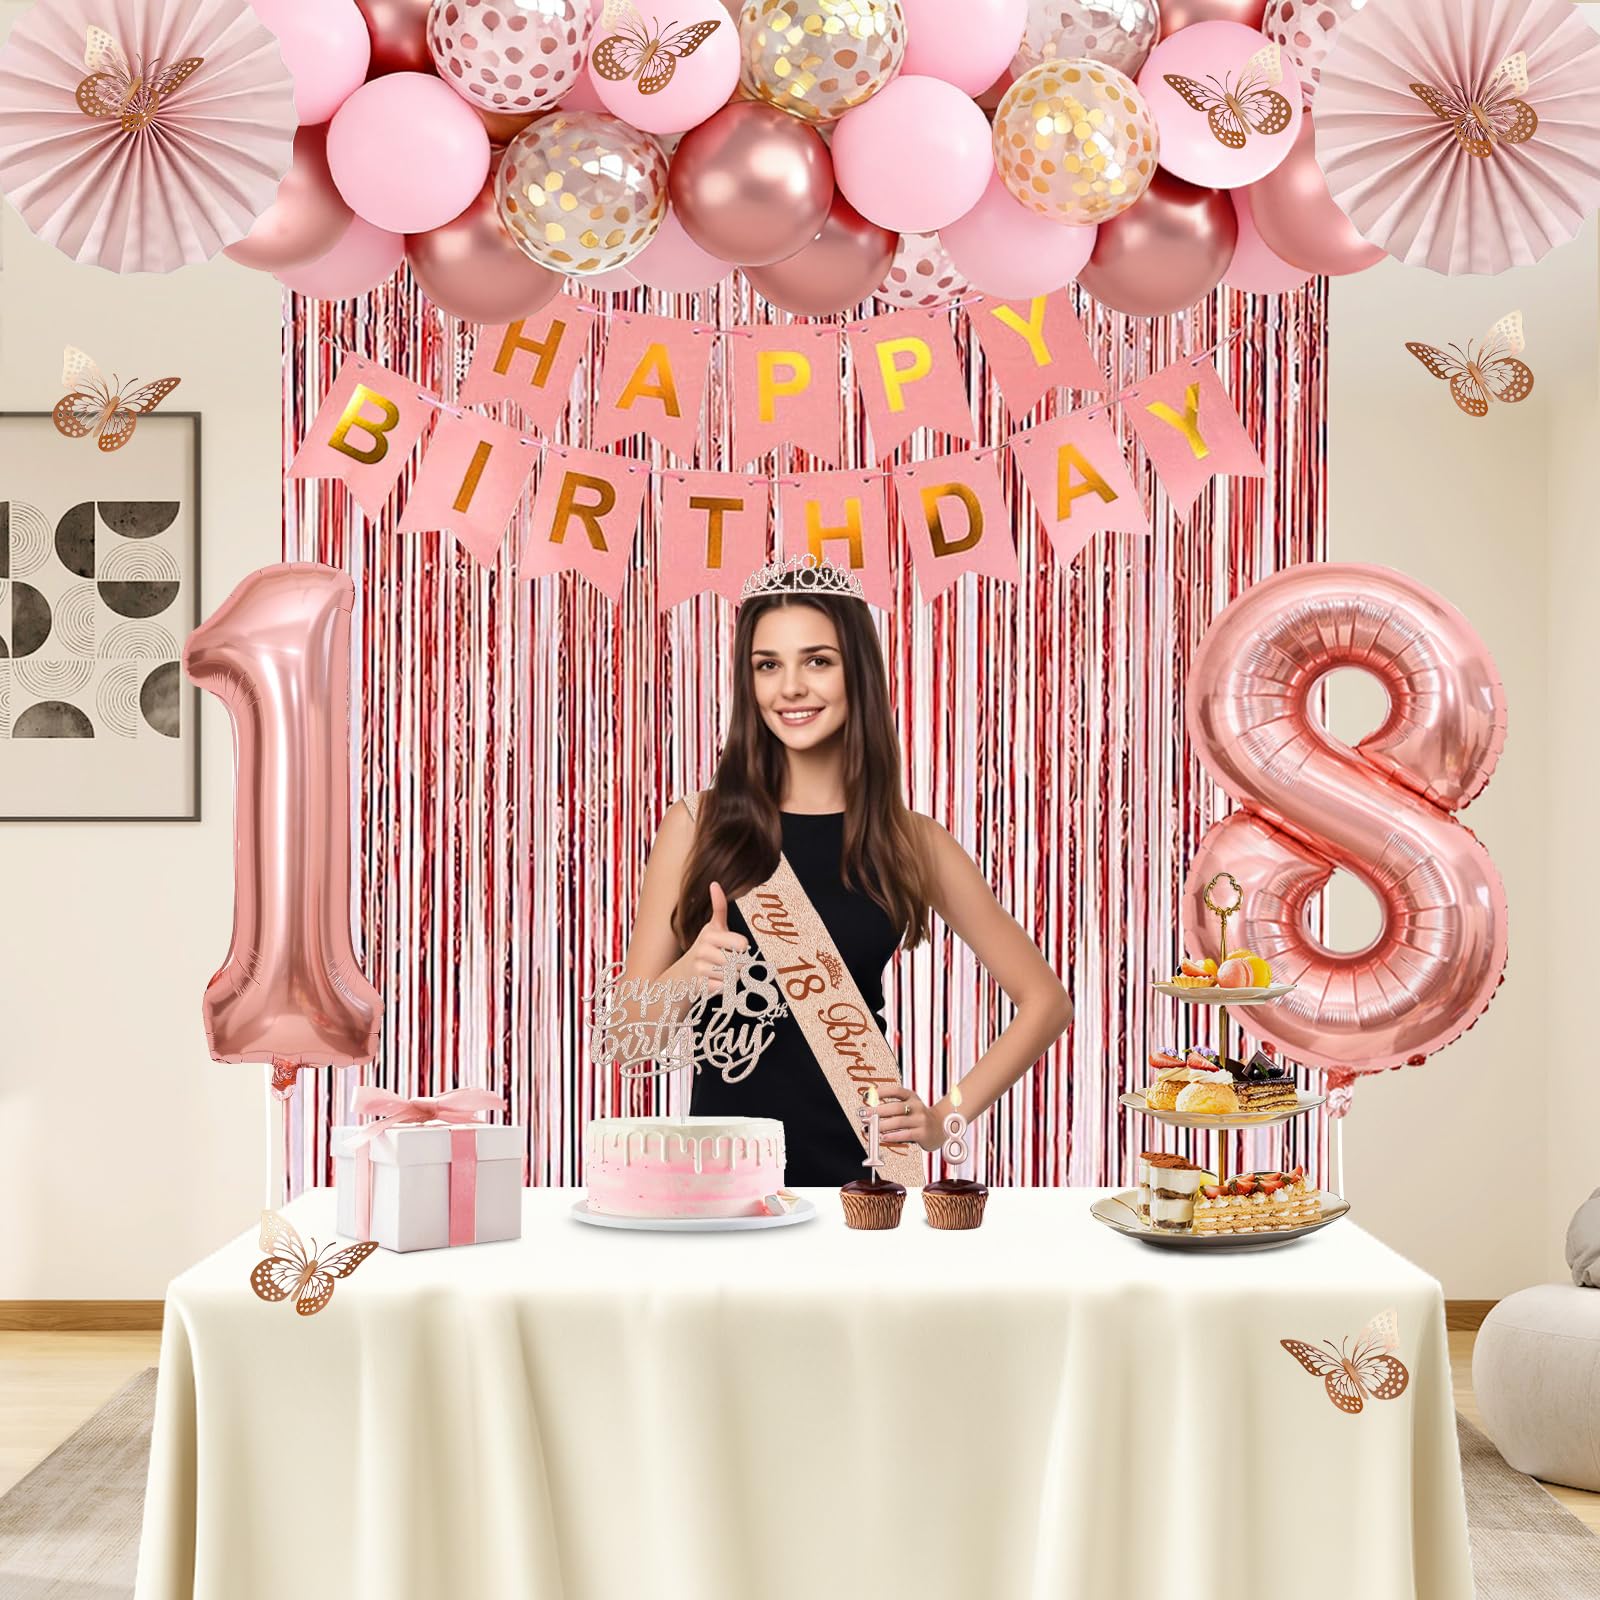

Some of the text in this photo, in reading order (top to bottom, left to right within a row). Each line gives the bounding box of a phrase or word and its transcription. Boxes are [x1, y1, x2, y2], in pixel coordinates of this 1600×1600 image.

[493, 296, 1052, 423] HAPPY
[328, 382, 1209, 570] BIRTHDAY
[184, 561, 385, 1068] 1
[1185, 561, 1507, 1070] 8
[751, 893, 800, 945] my
[777, 956, 826, 1001] 18
